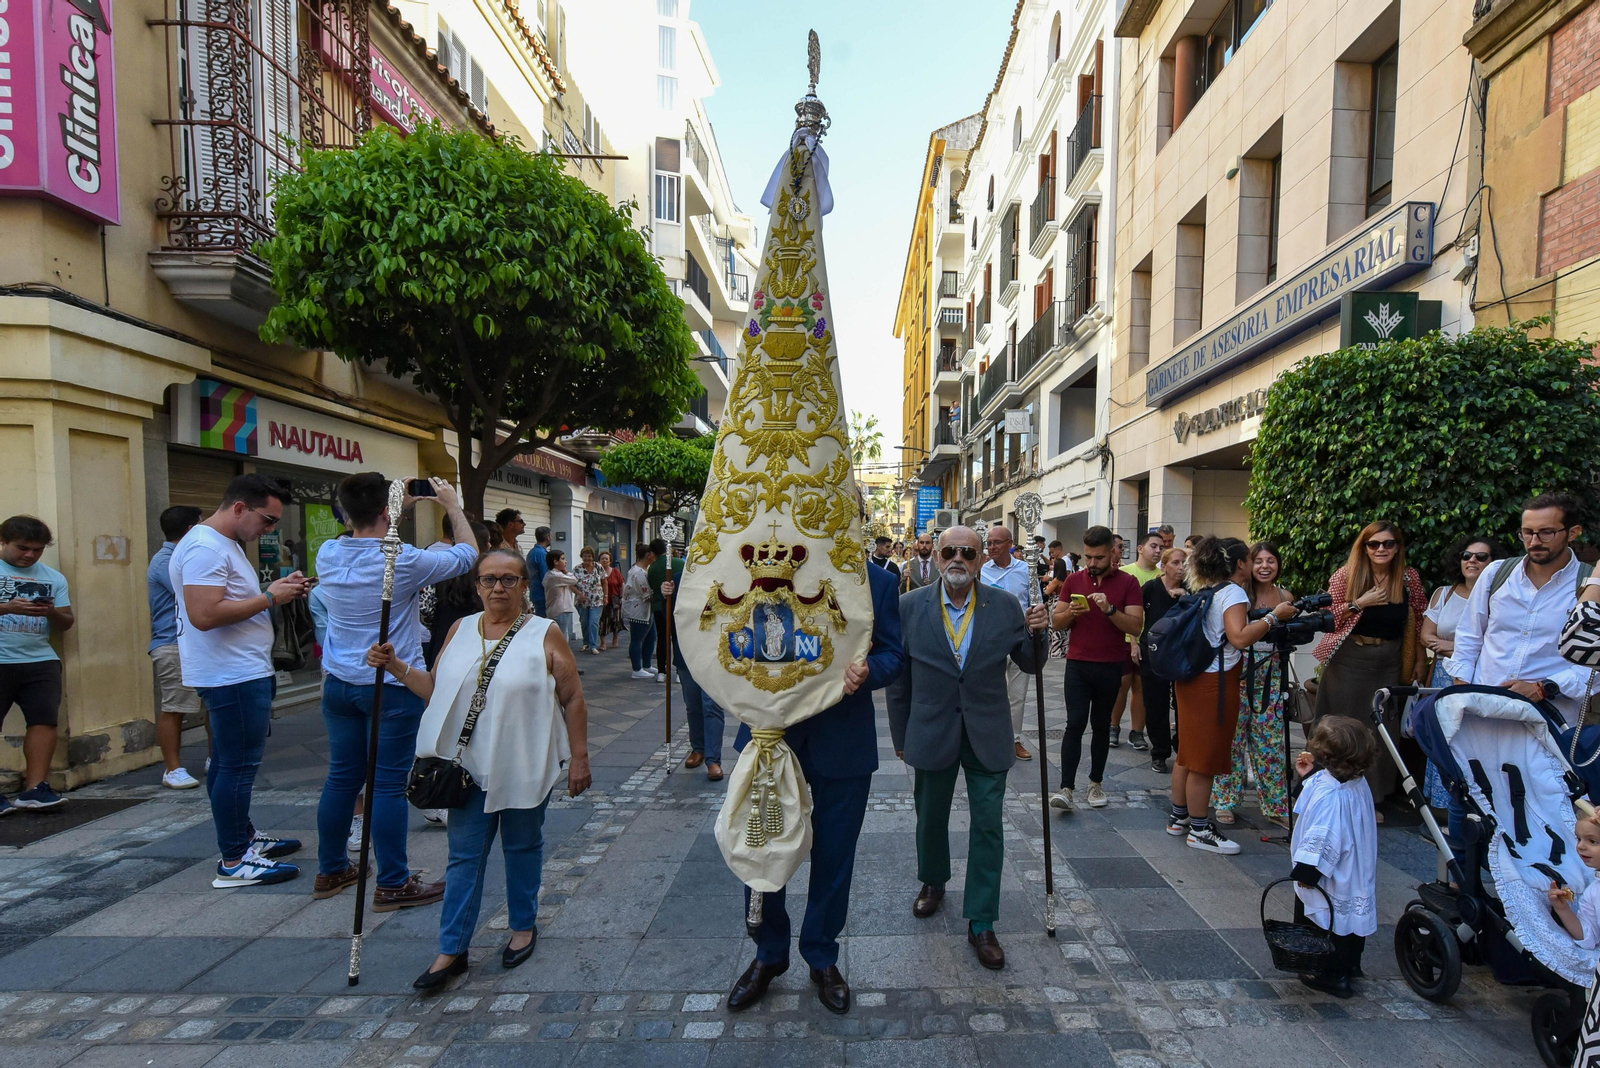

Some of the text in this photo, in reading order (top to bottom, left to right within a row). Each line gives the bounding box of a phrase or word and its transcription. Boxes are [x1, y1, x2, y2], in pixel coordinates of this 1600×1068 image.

[1148, 226, 1400, 396] GABINETE DE ASESORIA EMPRESARIAL
[1010, 417, 1026, 426] P&P
[269, 421, 364, 464] NAUTALIA
[525, 454, 556, 473] CORUÑA
[559, 463, 572, 478] 1959
[506, 472, 532, 489] CORUÑA
[491, 635, 513, 661] BIMBA
